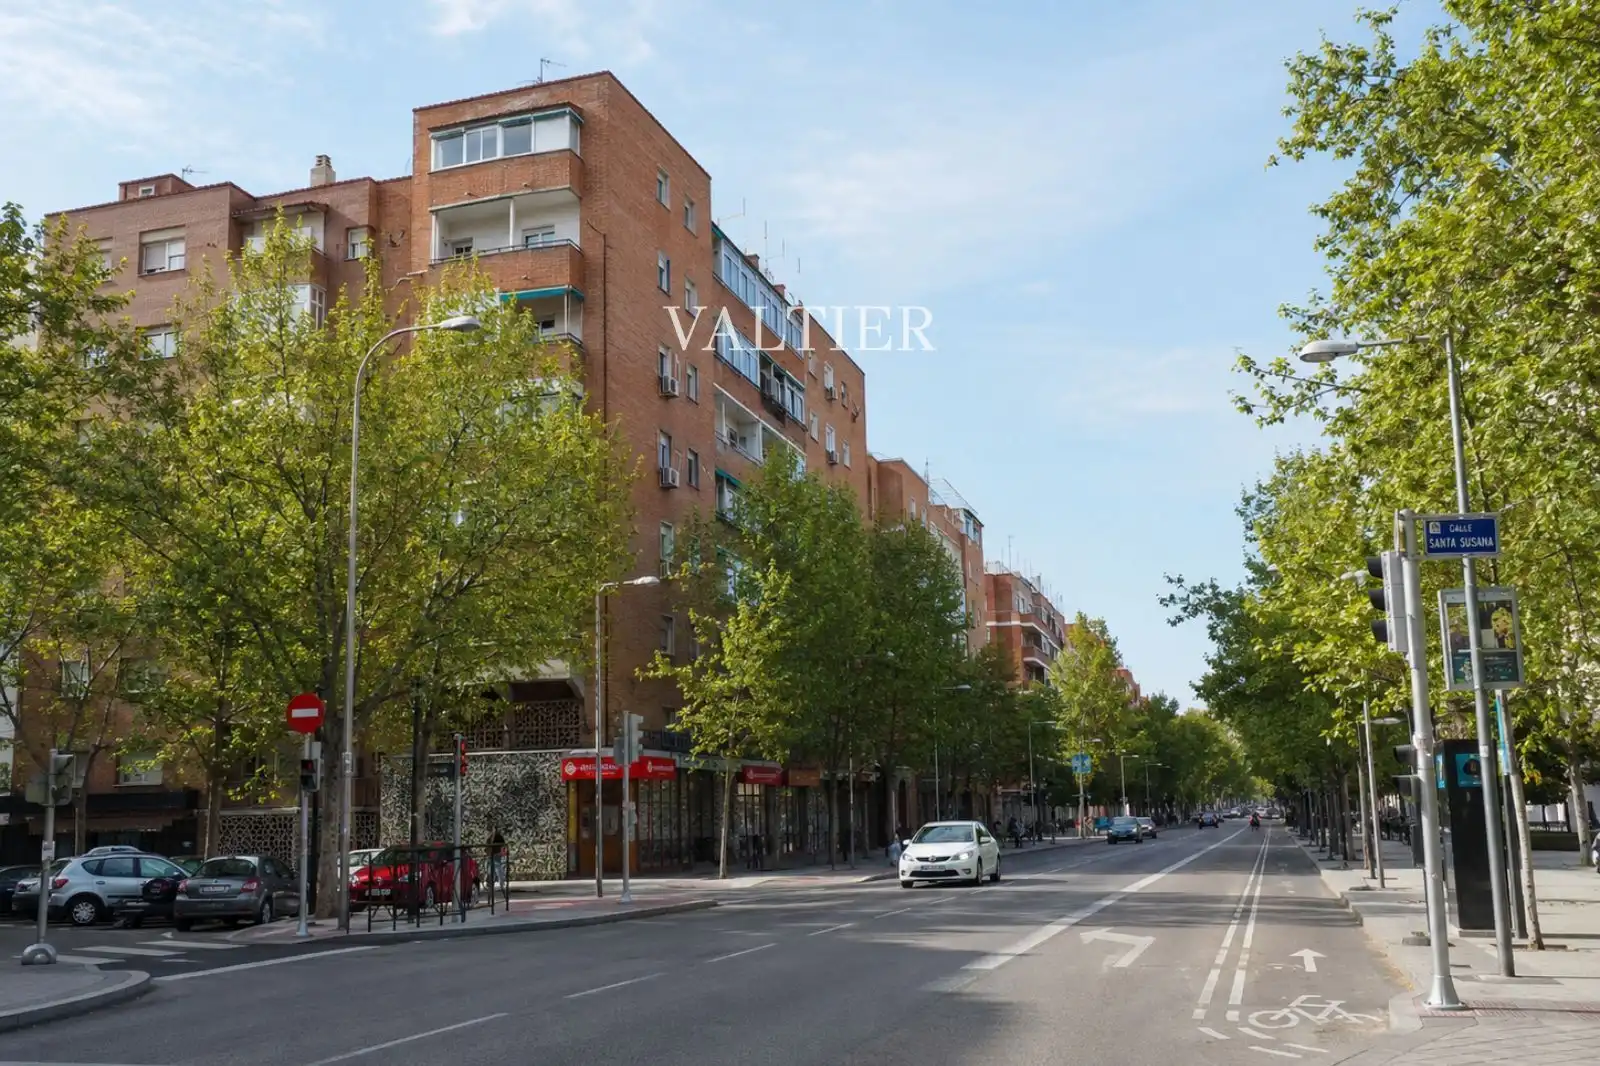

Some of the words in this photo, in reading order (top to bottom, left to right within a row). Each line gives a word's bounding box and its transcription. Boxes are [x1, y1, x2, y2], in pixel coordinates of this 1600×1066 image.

[1449, 524, 1472, 533] CALLE
[1429, 537, 1457, 549] SANTA
[1460, 536, 1494, 548] SUSANA
